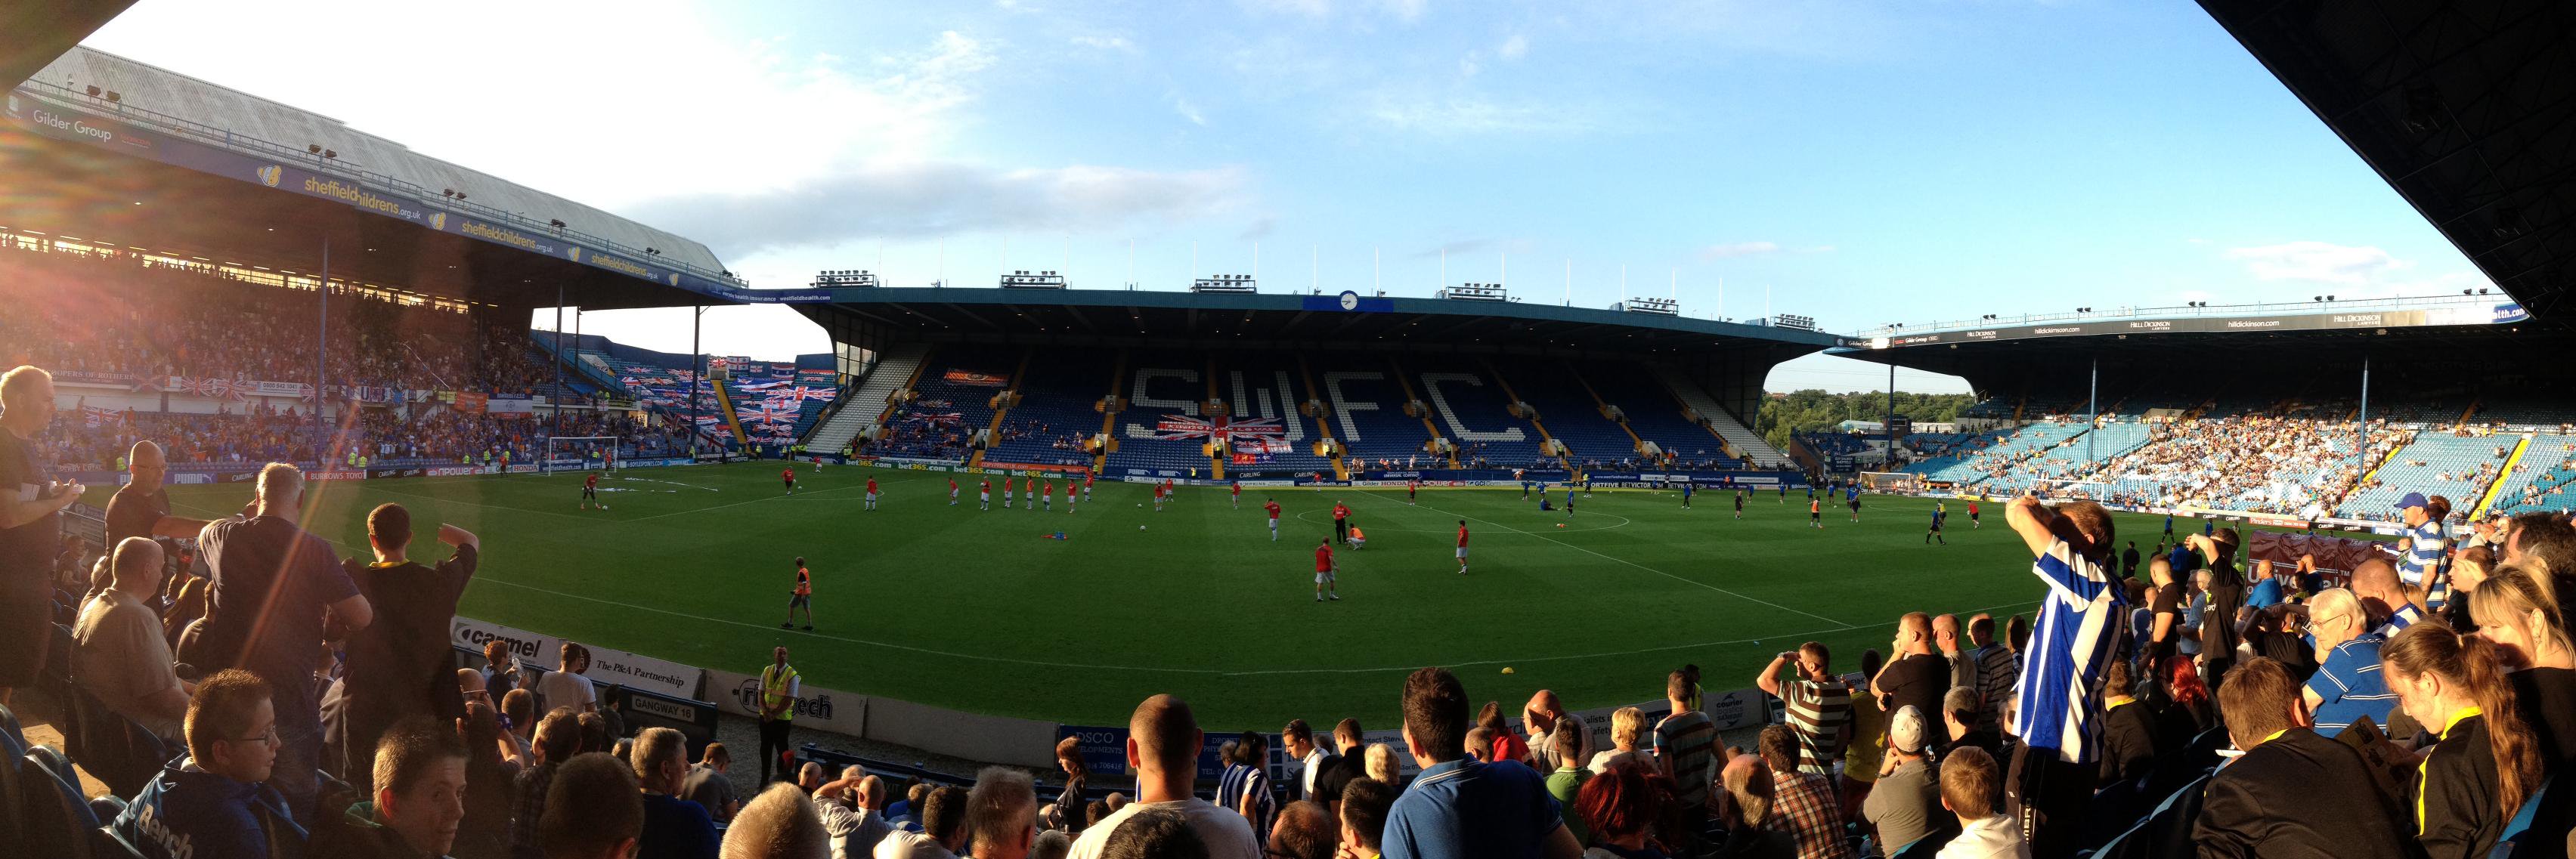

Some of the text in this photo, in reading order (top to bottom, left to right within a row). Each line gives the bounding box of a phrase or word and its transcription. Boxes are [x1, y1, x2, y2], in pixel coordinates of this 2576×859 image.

[34, 109, 70, 130] Gilder
[74, 120, 112, 143] Group
[1126, 367, 1526, 443] SWFC
[542, 463, 582, 471] wetfieldhealth.com
[845, 459, 892, 468] bet365.com
[898, 462, 946, 472] bet365.com
[378, 469, 396, 478] CARLING
[438, 467, 474, 477] npower
[953, 465, 1005, 475] bet365.com
[1011, 469, 1062, 479] bet365.com
[174, 473, 203, 484] PUMA
[231, 472, 254, 482] CARLING
[311, 472, 344, 480] BURROWS
[2250, 518, 2272, 526] Pinders
[596, 660, 684, 688] The P&A Partnership
[635, 698, 691, 718] GANGWAY 16
[1717, 700, 1743, 709] courier
[1585, 715, 1605, 725] alists
[1079, 746, 1123, 755] ELOPMENTS
[138, 803, 194, 859] Bench
